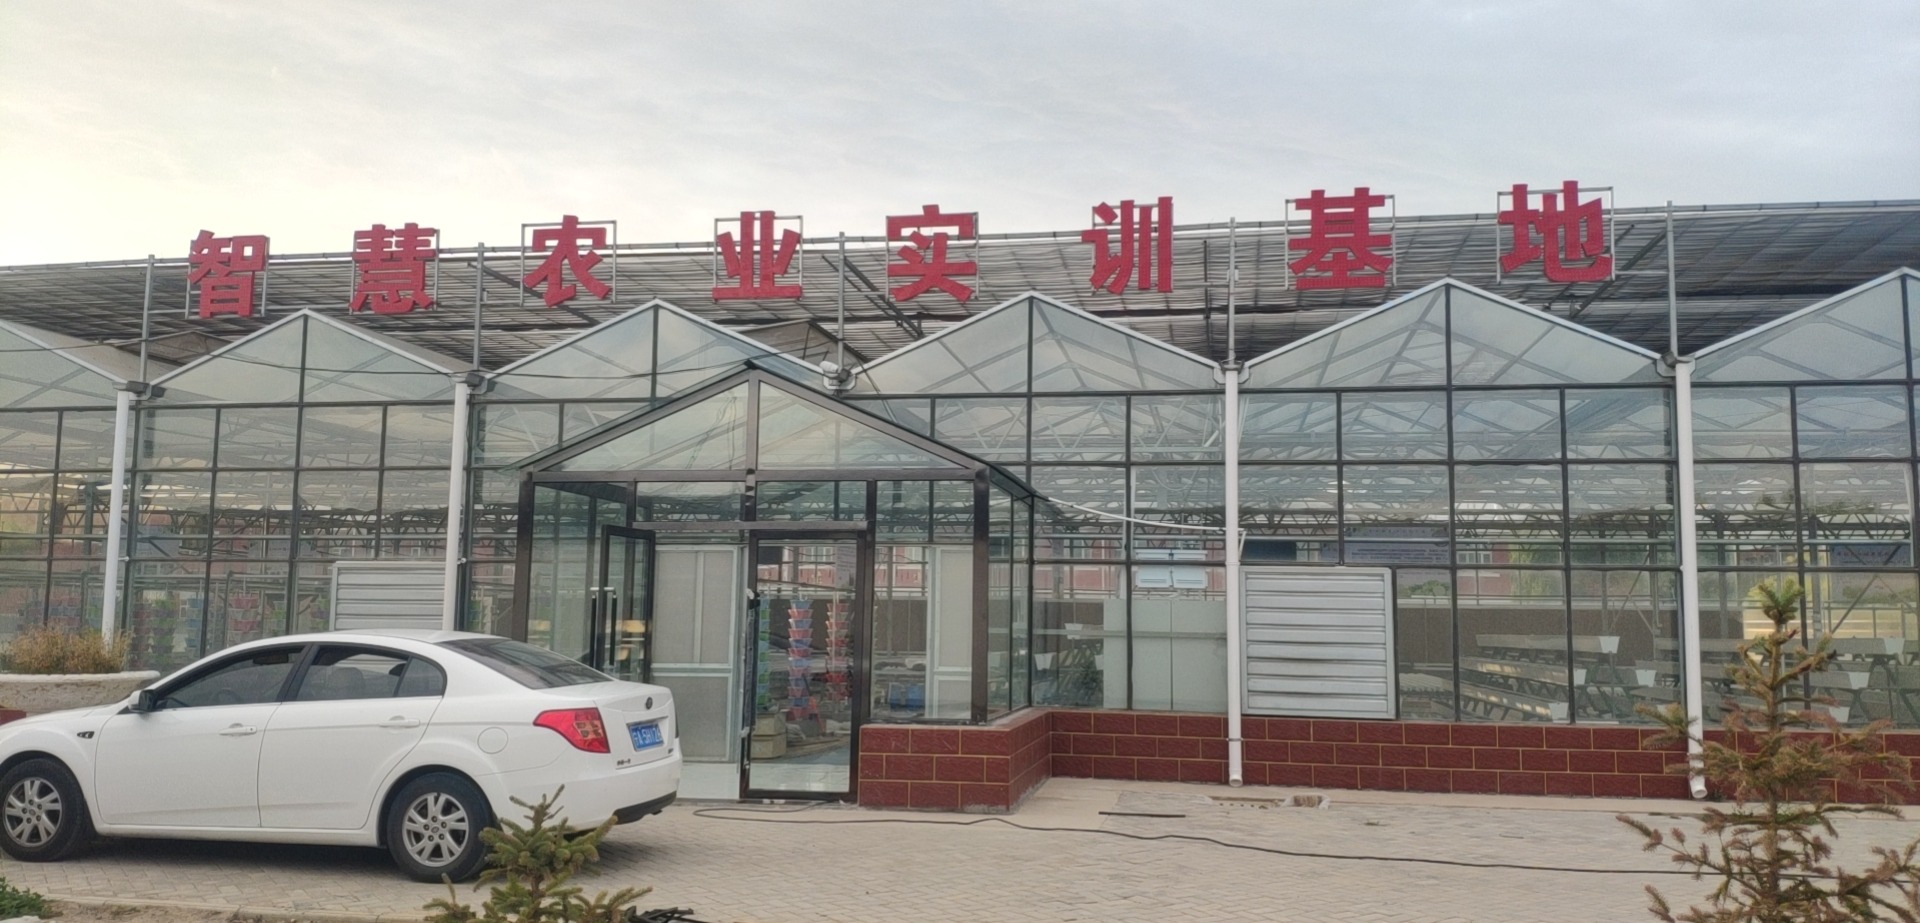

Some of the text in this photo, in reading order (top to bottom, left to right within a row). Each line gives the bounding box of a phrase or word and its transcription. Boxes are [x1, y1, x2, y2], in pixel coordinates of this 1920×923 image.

[189, 180, 1613, 319] 智慧农业实训基地
